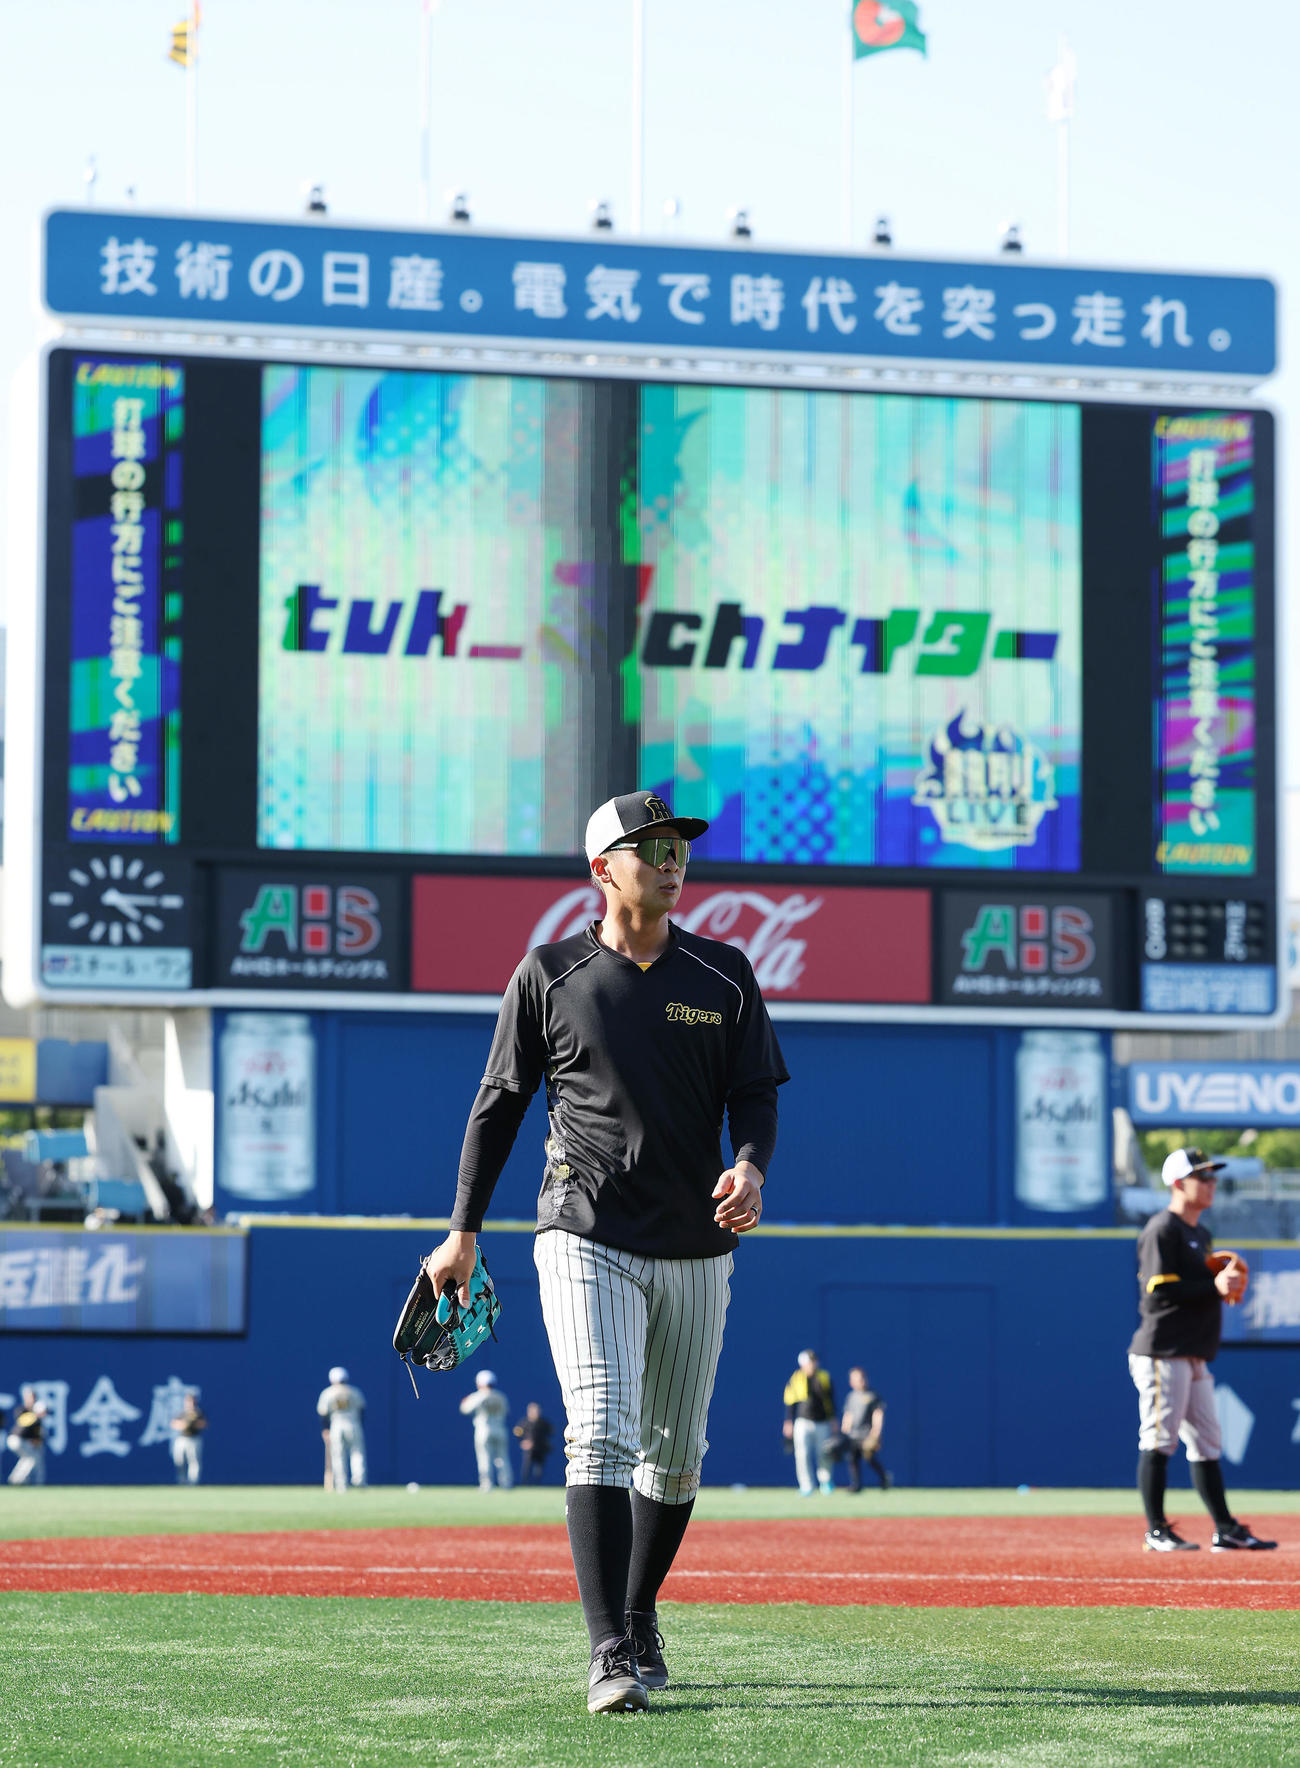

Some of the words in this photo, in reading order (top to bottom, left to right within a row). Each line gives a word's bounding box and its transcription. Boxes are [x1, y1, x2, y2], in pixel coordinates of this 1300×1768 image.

[100, 236, 1233, 352] 技術の日産。電気で時代を突っ走れ。
[947, 800, 1029, 826] LIVE
[665, 1002, 722, 1025] Tigers
[1135, 1072, 1300, 1115] UYENO
